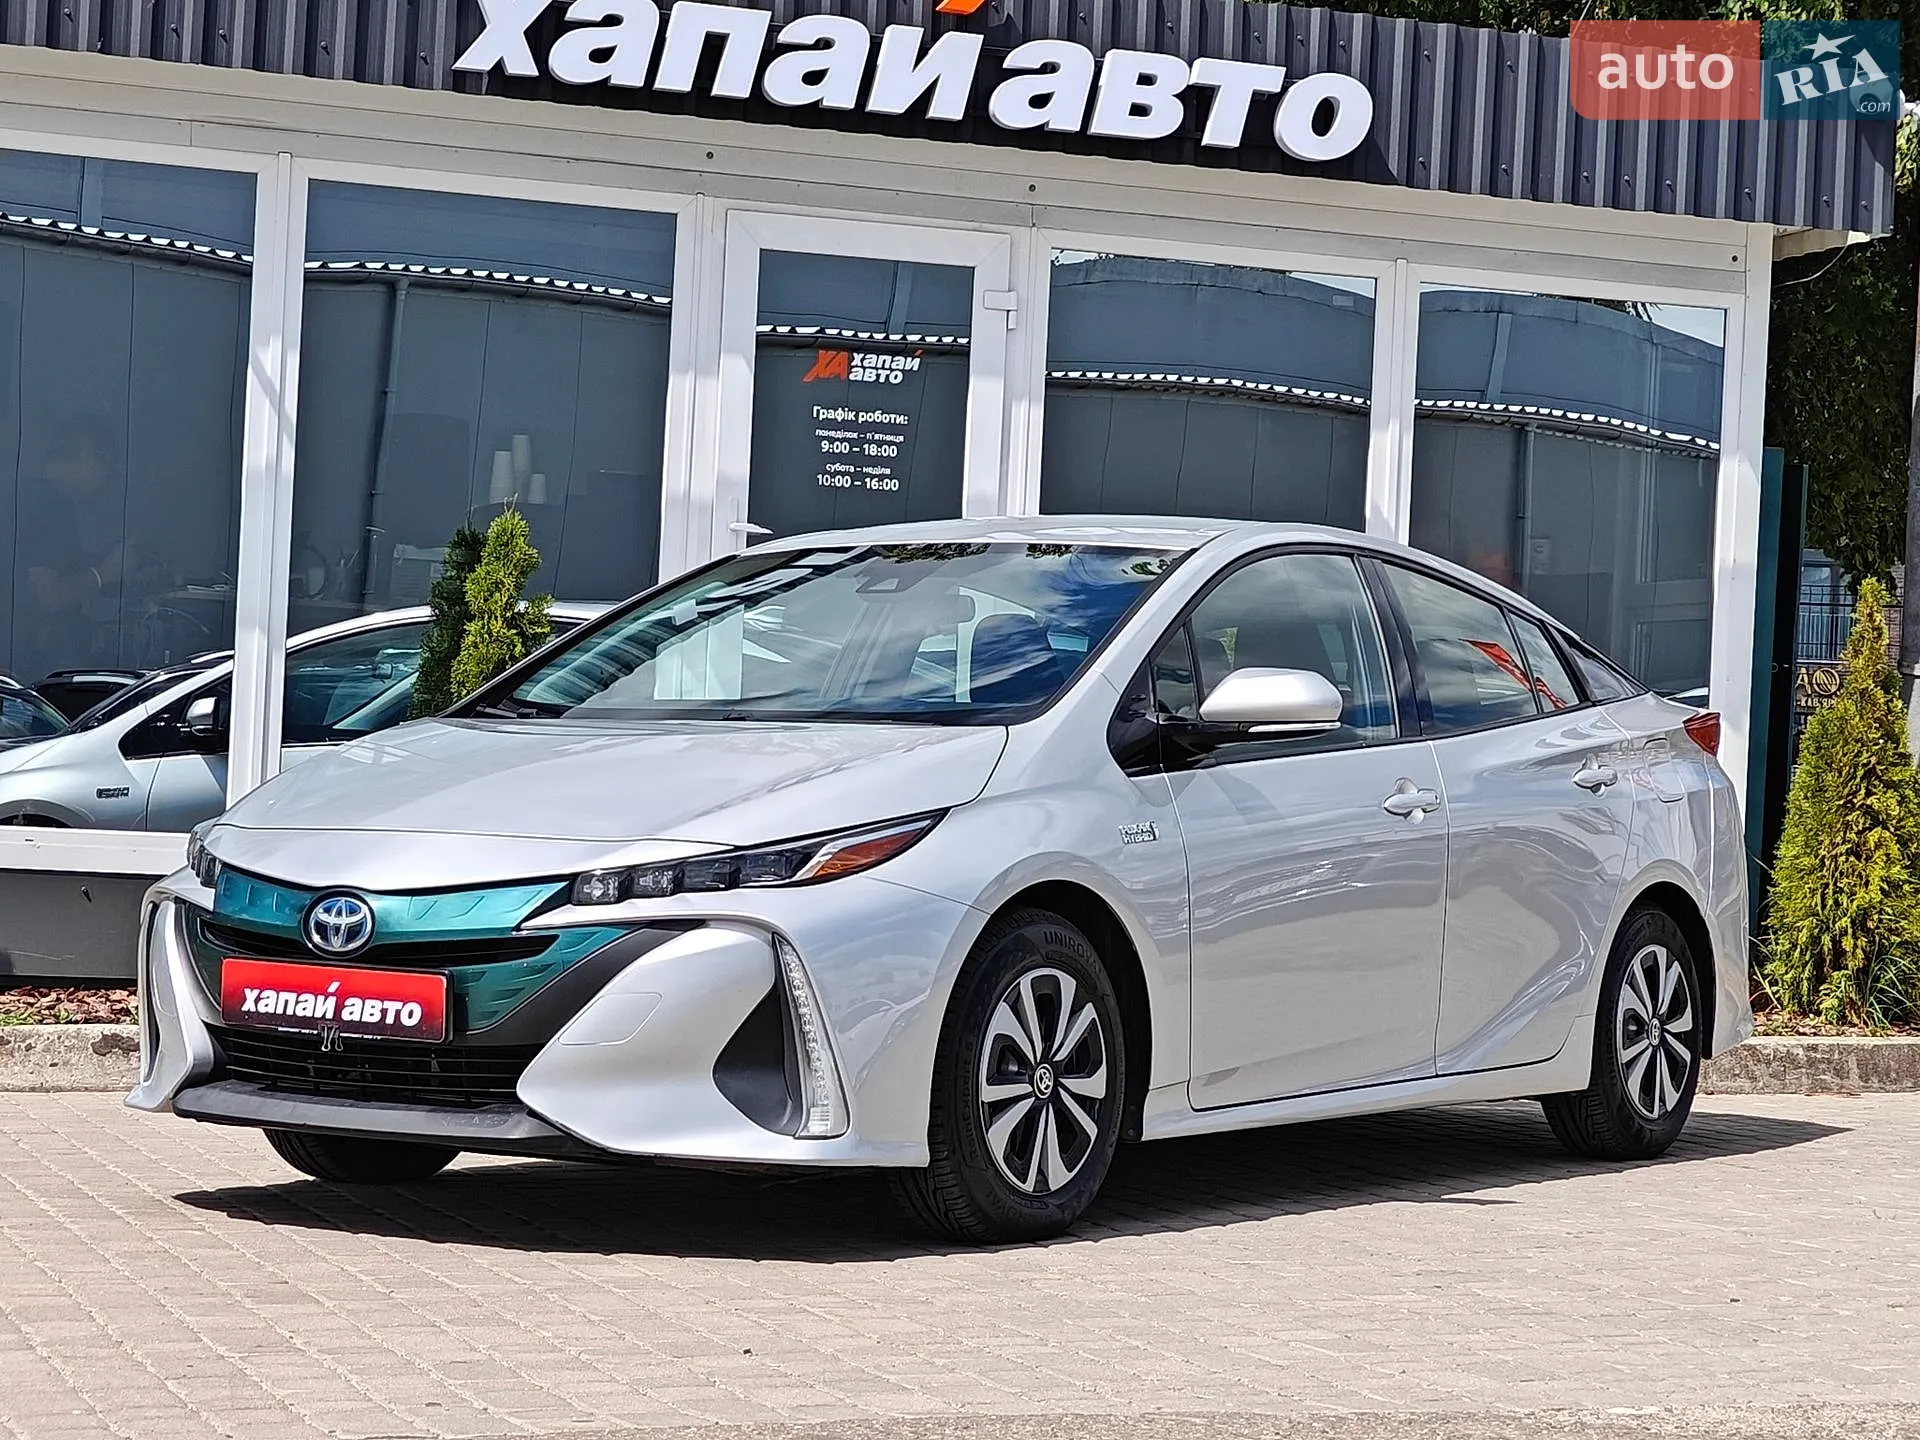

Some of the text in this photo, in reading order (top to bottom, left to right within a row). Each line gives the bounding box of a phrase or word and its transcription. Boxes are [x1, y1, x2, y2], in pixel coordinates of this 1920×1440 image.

[988, 39, 1374, 162] авто
[851, 349, 923, 371] хапай
[849, 367, 903, 384] авто
[812, 405, 909, 425] Графік роботи:
[821, 440, 850, 454] 9:00
[862, 443, 898, 457] 18:00
[825, 463, 855, 473] субота
[862, 466, 891, 475] неділя
[816, 474, 851, 488] 10:00
[864, 477, 900, 491] 16:00
[241, 981, 423, 1028] хапай авто
